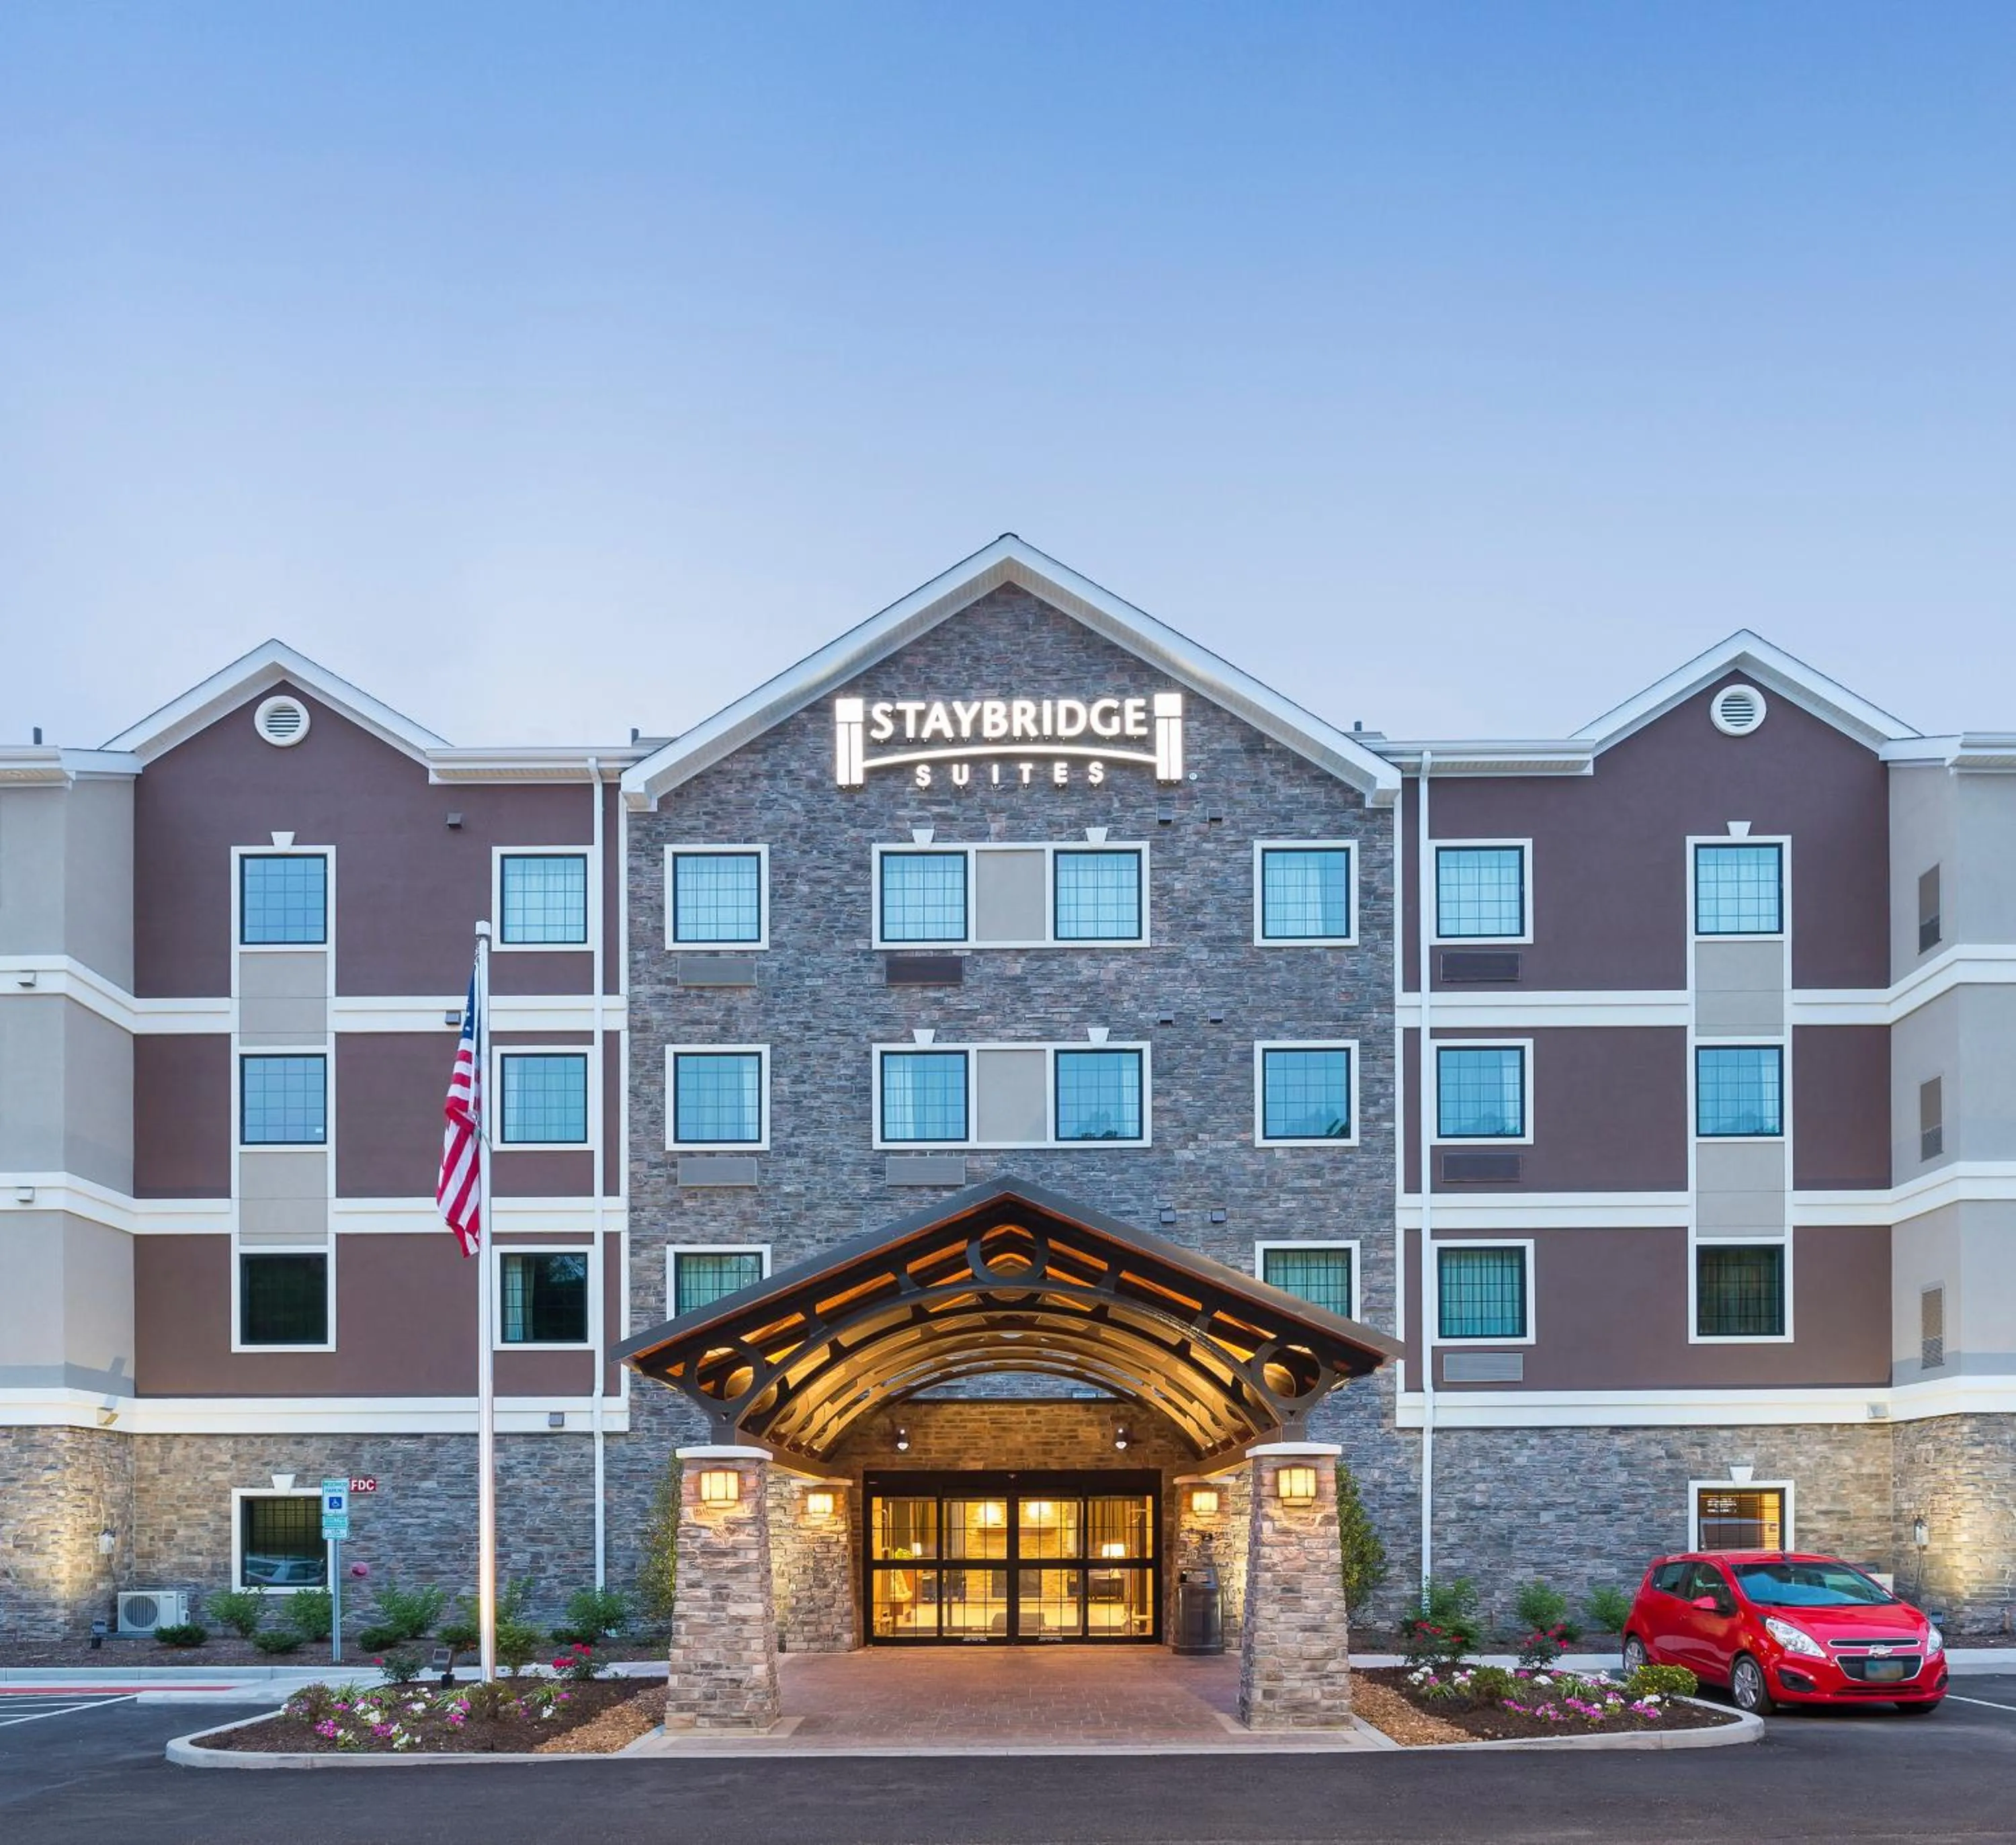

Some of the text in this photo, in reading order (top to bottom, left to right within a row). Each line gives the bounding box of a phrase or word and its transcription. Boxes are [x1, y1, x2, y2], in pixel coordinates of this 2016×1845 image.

[870, 699, 1148, 738] STAYBRIDGE
[916, 762, 1104, 787] SUITES
[351, 1479, 374, 1491] FDC
